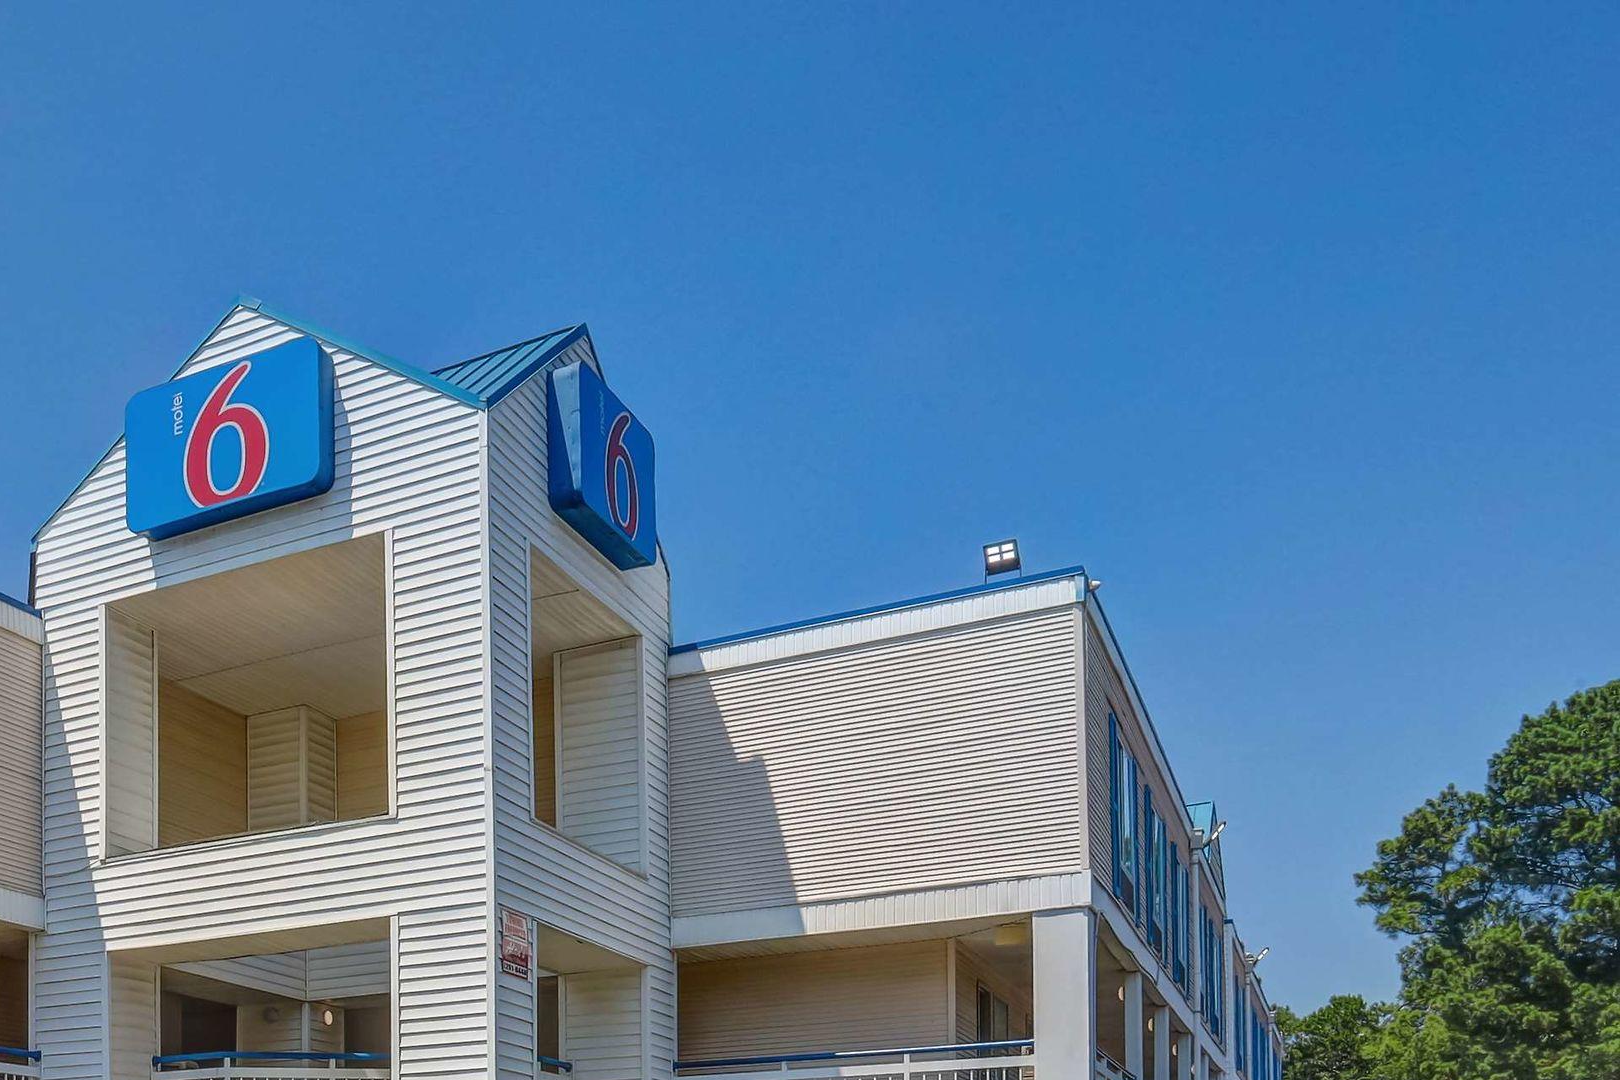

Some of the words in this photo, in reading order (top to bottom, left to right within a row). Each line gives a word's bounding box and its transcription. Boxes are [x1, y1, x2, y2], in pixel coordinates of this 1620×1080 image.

[171, 391, 184, 436] motel
[182, 360, 270, 509] 6
[604, 411, 640, 542] 6
